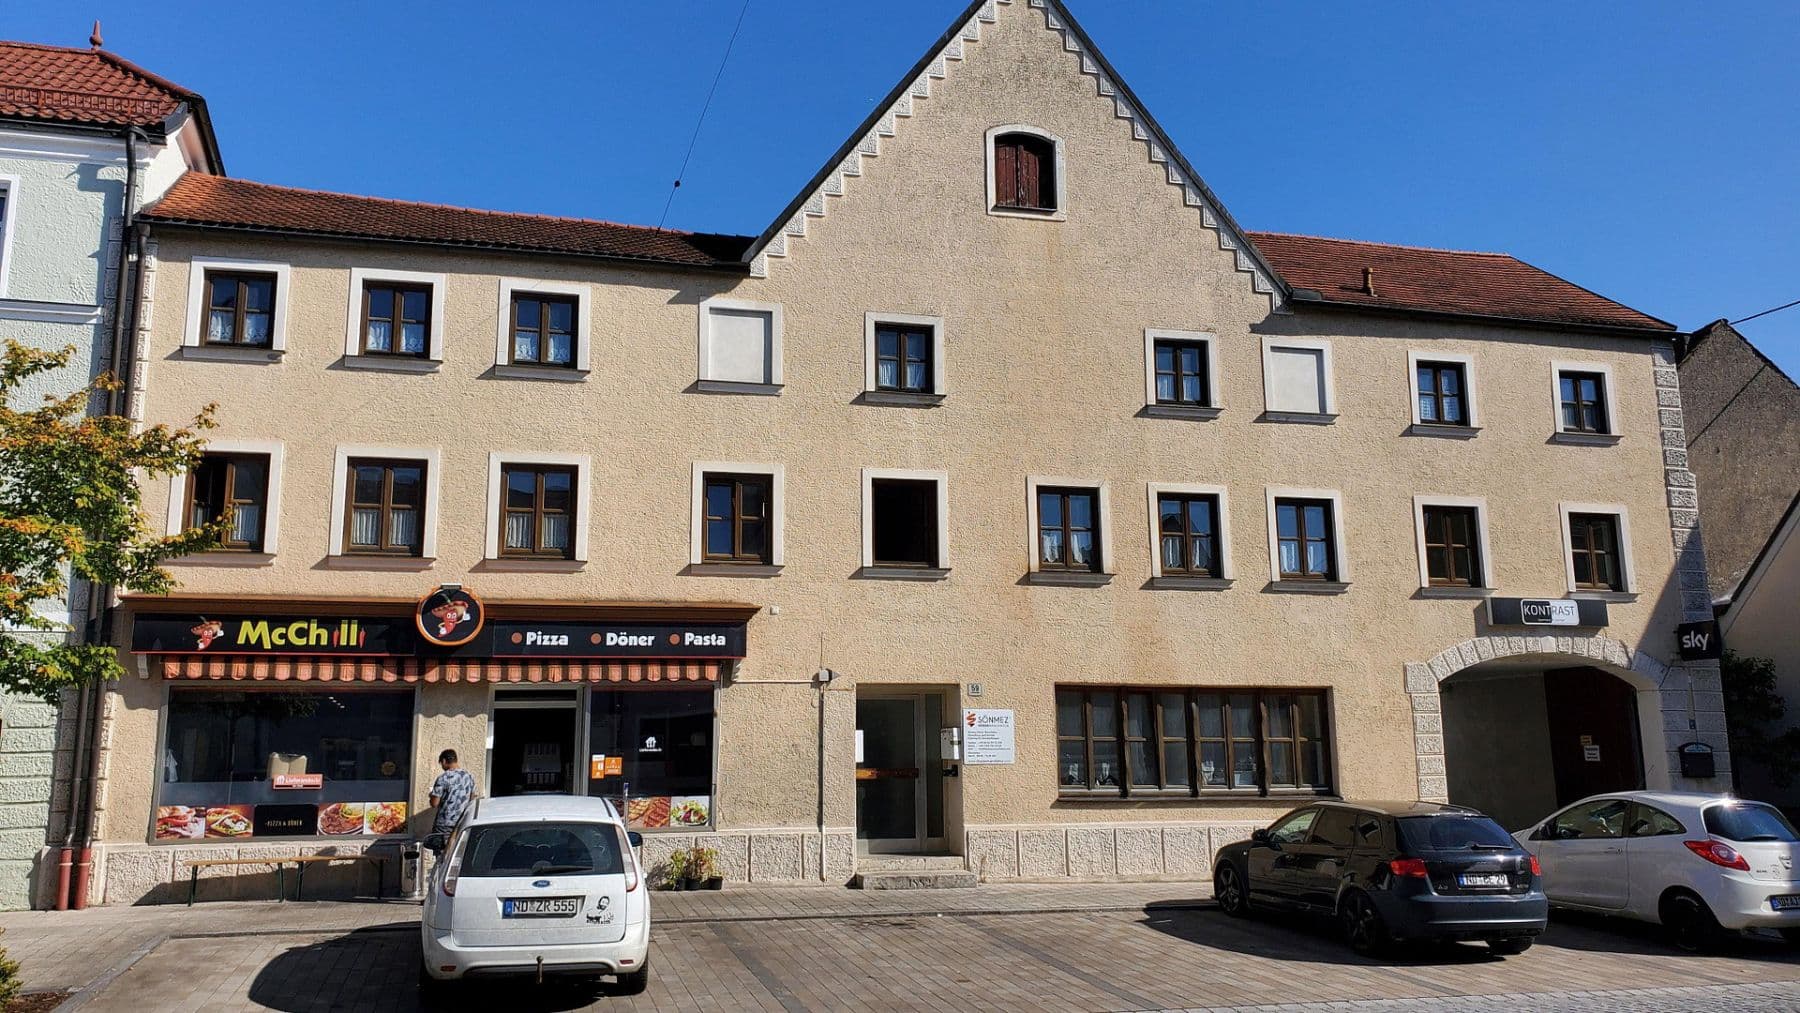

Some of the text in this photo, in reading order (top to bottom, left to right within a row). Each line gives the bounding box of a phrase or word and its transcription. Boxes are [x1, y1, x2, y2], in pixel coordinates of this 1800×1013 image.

[1523, 604, 1575, 616] KONTRAST
[526, 631, 726, 646] Pizza Döner Pasta
[1682, 630, 1709, 650] sky
[978, 715, 1009, 724] SÖNMEZ
[513, 900, 575, 912] ND ZR 555
